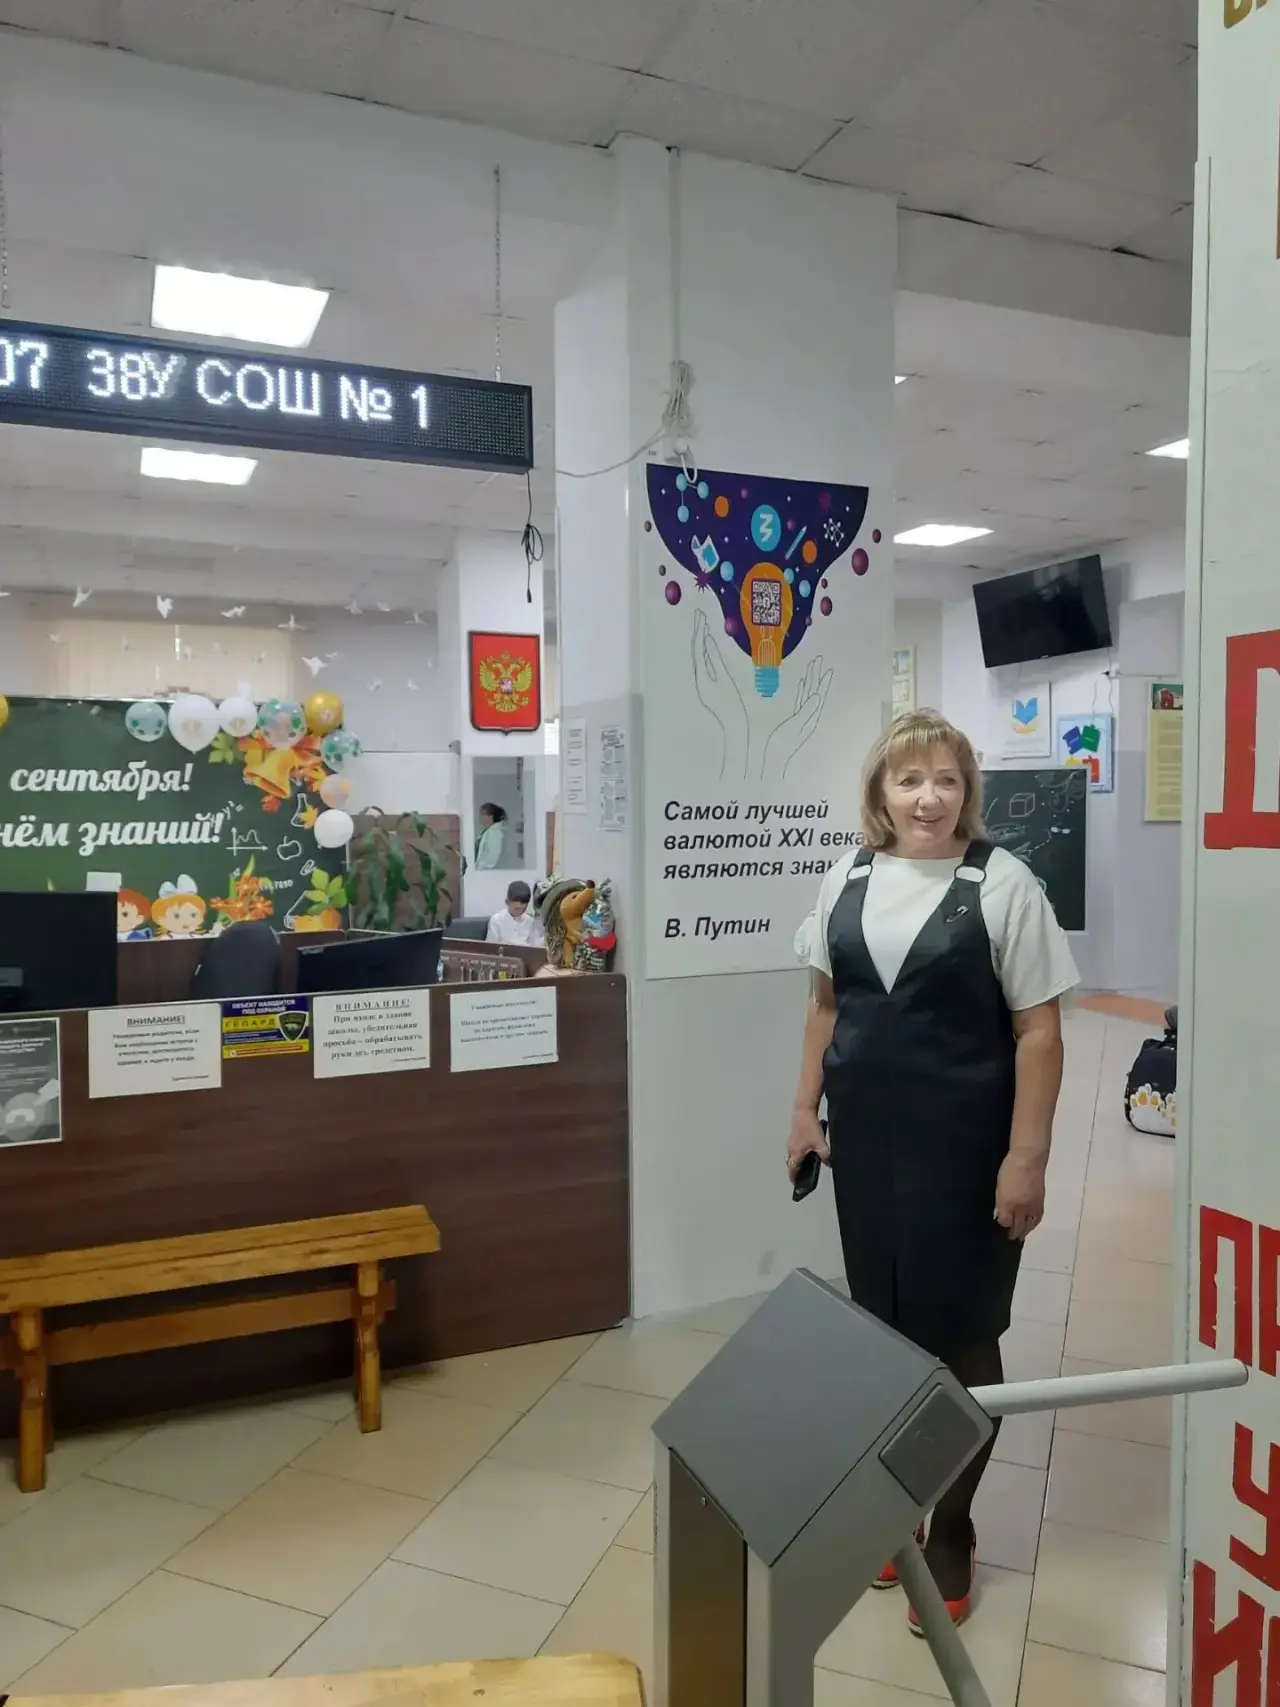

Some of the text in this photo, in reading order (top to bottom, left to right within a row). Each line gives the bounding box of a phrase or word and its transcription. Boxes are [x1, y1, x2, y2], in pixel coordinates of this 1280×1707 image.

[197, 359, 321, 417] СОШ
[338, 376, 393, 422] №
[409, 384, 430, 429] 1
[10, 760, 194, 802] сентября!
[664, 799, 830, 825] Самой лучшей
[78, 811, 225, 857] знаний!
[664, 828, 865, 850] валютой XXI века
[663, 860, 784, 880] являются
[664, 916, 771, 941] В. Путин
[127, 1014, 186, 1027] ВНИМАНИЕ!
[333, 1014, 352, 1024] При
